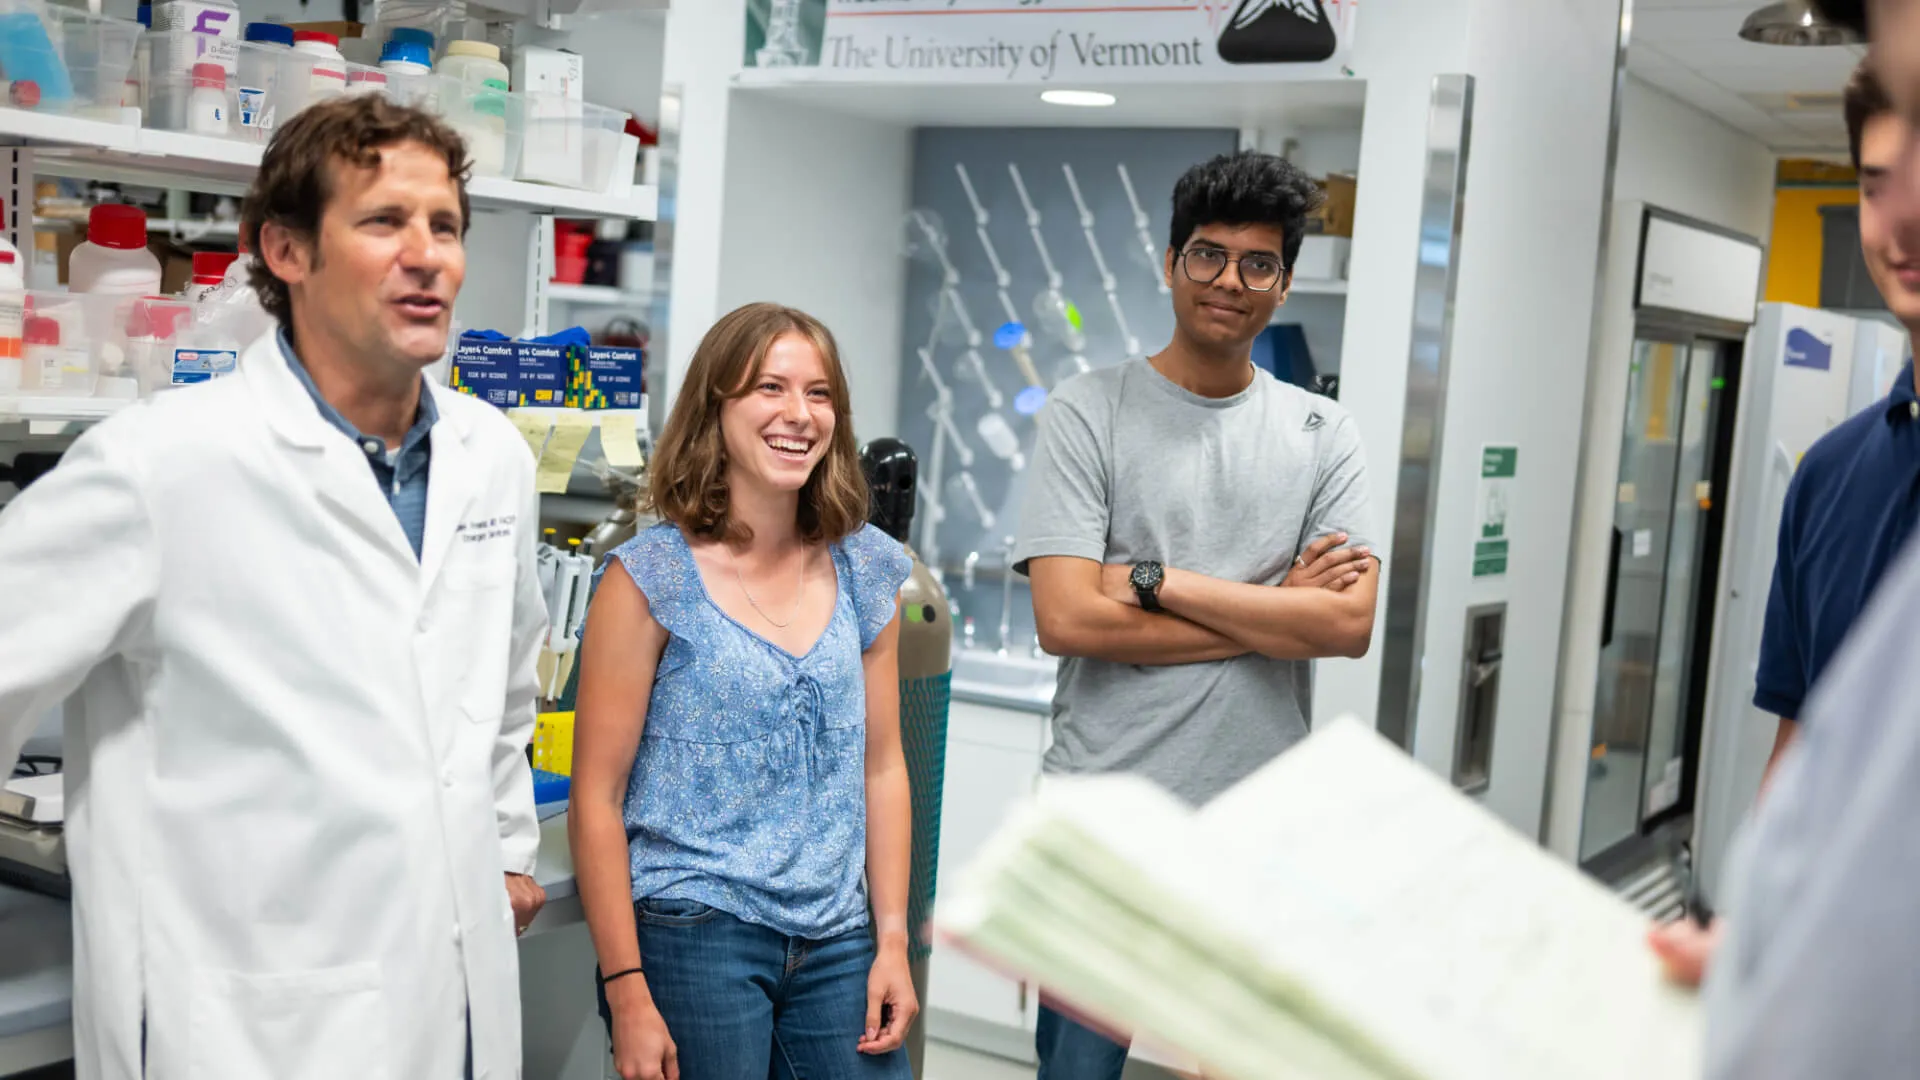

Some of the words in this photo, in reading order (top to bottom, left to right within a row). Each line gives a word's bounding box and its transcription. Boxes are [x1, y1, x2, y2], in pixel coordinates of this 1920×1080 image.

[829, 34, 877, 69] The
[884, 35, 1023, 80] University
[1030, 29, 1062, 80] of
[1069, 32, 1203, 67] Vermont
[483, 345, 512, 356] Comfort
